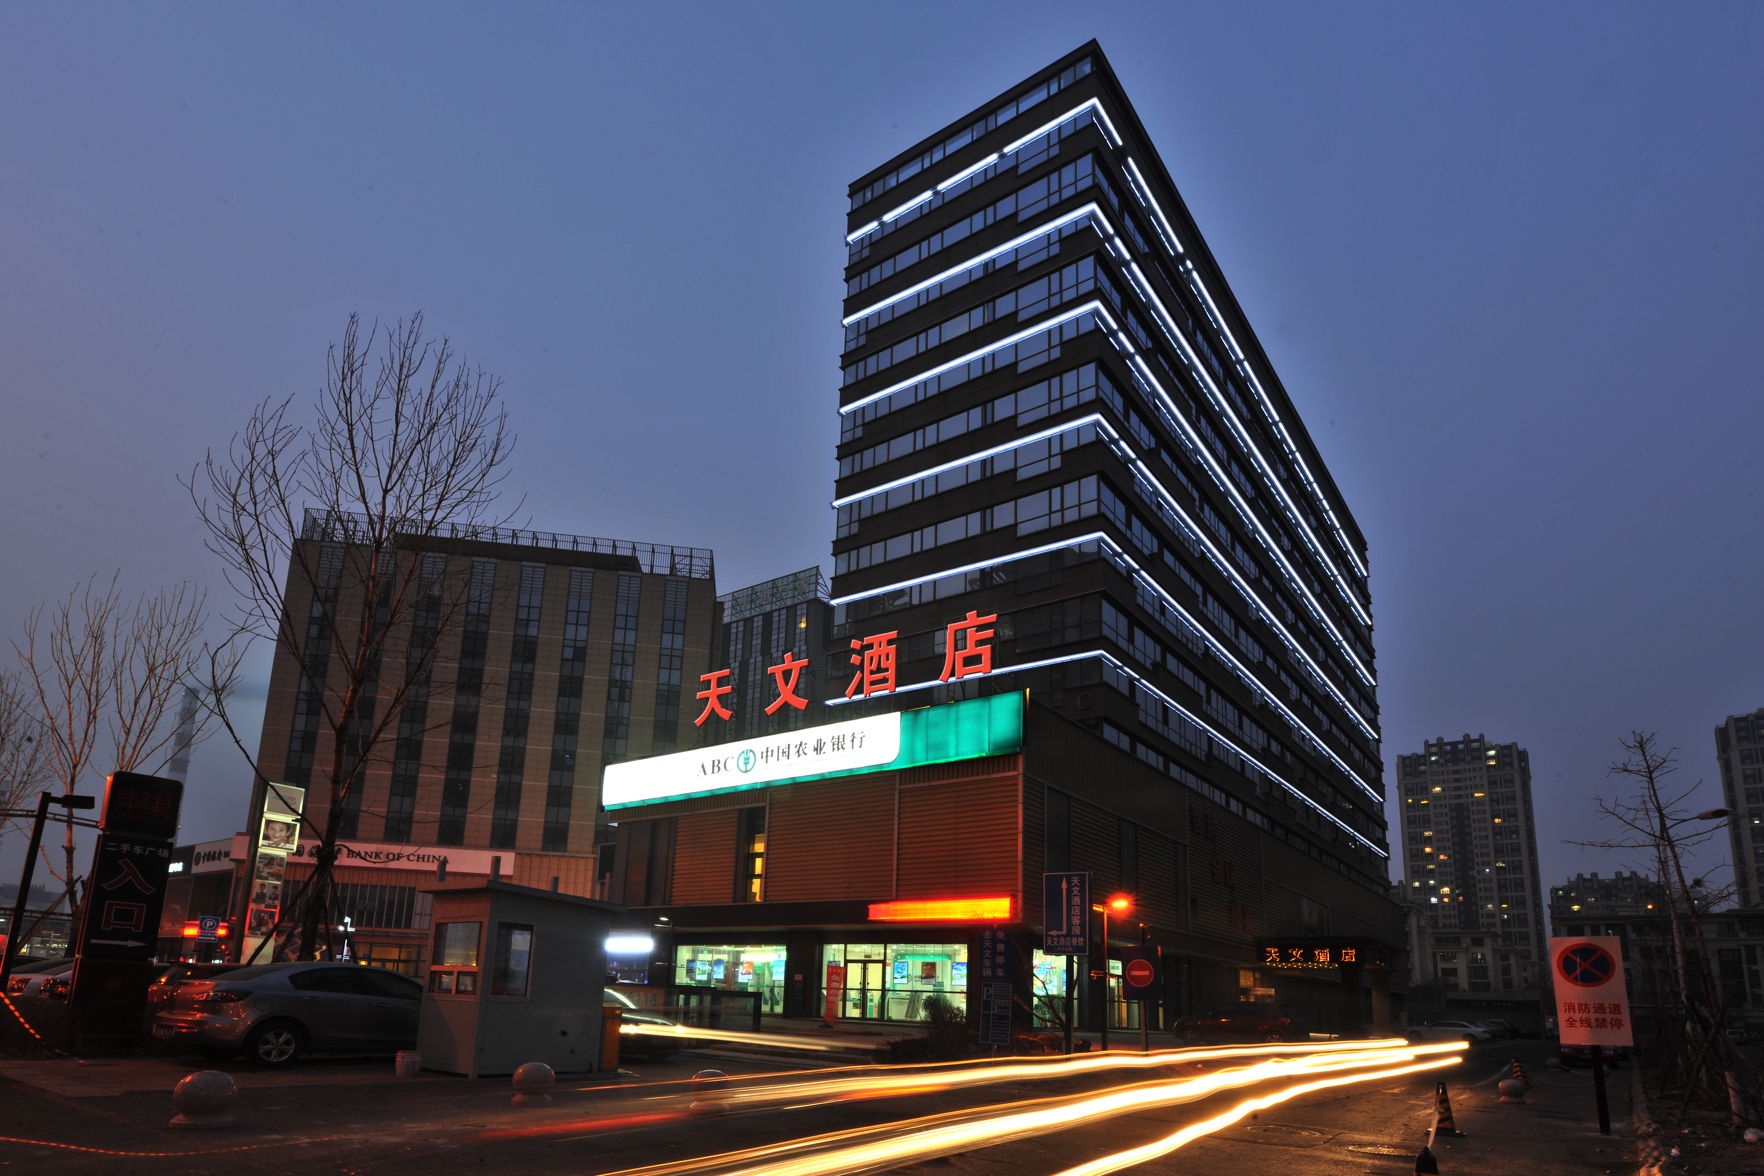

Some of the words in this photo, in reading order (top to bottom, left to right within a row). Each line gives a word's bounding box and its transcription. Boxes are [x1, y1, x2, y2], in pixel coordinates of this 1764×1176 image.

[694, 610, 998, 727] 天文酒店
[760, 731, 866, 763] 中国农业银行
[697, 756, 735, 777] ABC
[105, 842, 170, 859] 二手车广场
[346, 850, 384, 860] BANK
[386, 852, 404, 862] OF
[407, 852, 450, 864] CHINA
[101, 858, 156, 933] 入口
[1071, 876, 1081, 936] 天文酒店客房
[1046, 936, 1085, 947] 天文酒店餐饮
[982, 930, 992, 977] 去天文车辆
[995, 930, 1006, 977] 免费停车
[1265, 947, 1356, 962] 天文酒店
[1563, 1002, 1622, 1015] 消防通道
[1565, 1016, 1624, 1029] 全线禁停
